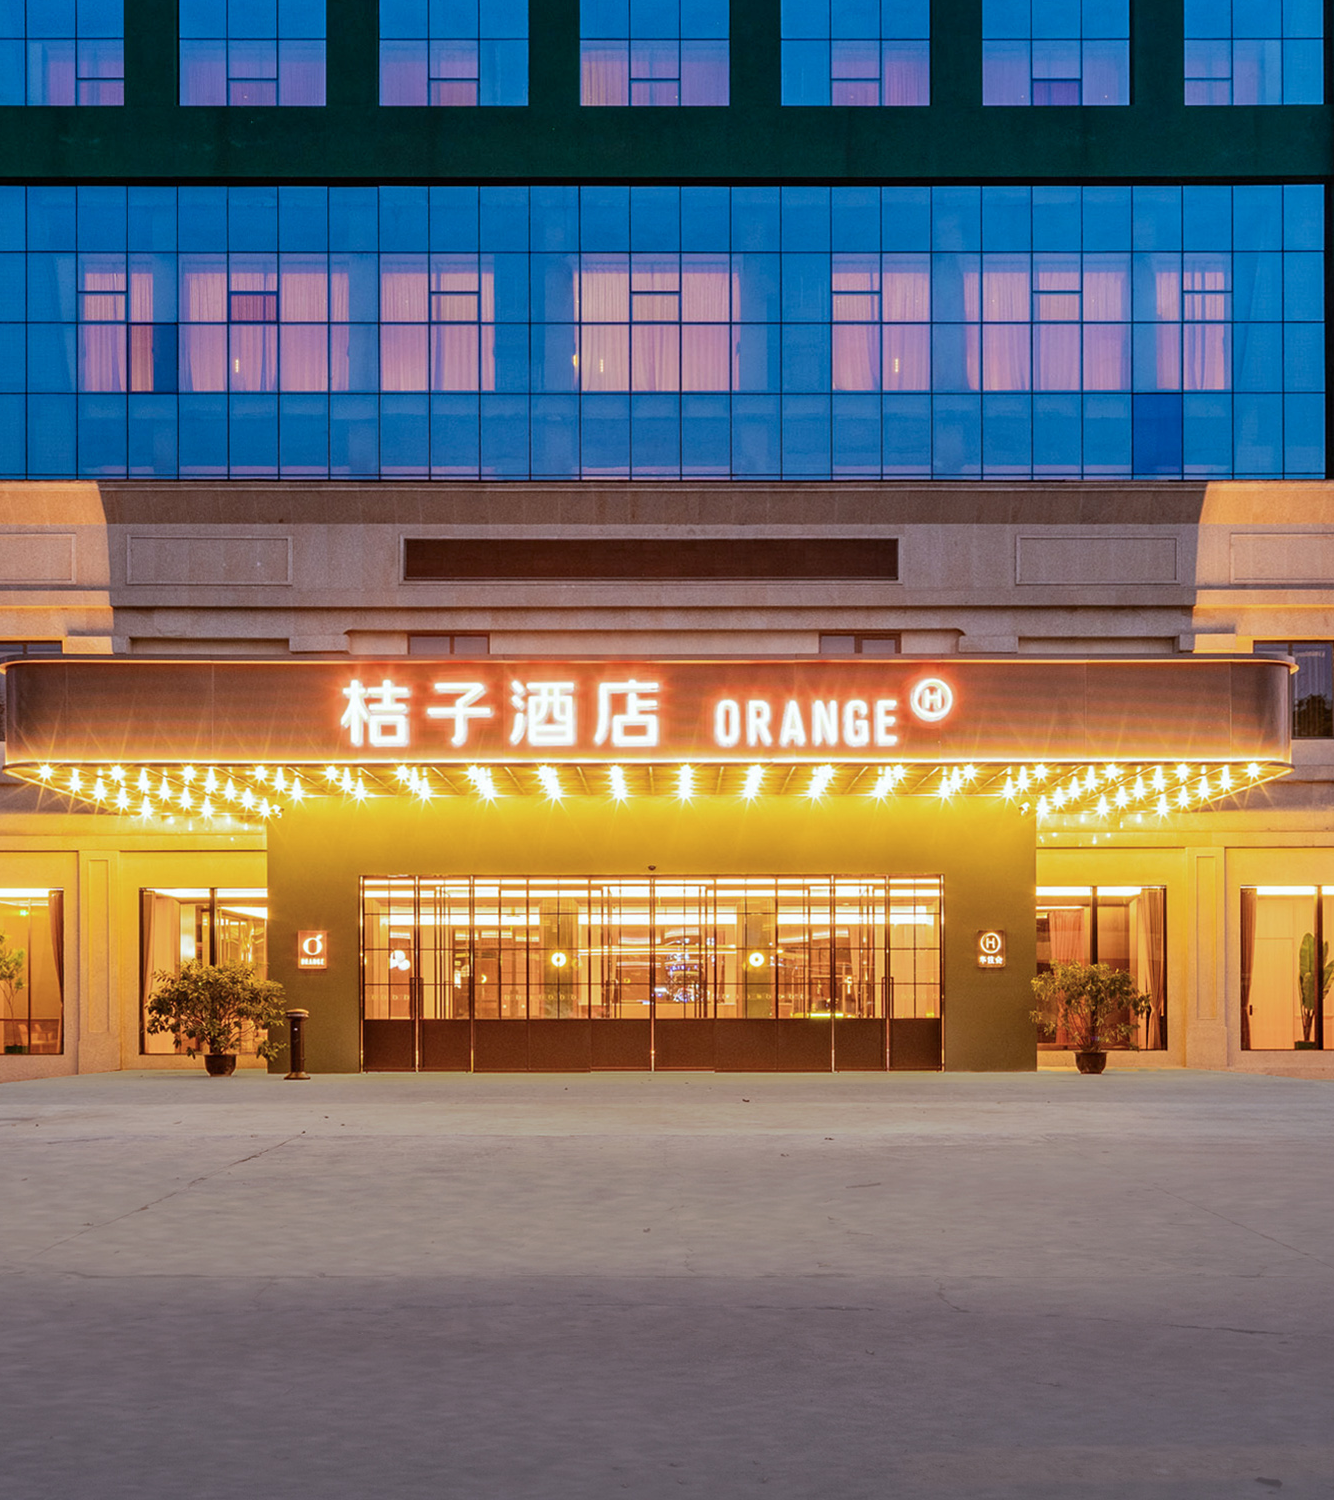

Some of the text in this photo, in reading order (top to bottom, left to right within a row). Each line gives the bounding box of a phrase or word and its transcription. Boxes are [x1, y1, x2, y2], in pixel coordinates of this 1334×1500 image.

[341, 678, 659, 747] 桔子酒店
[714, 699, 898, 747] ORANGE
